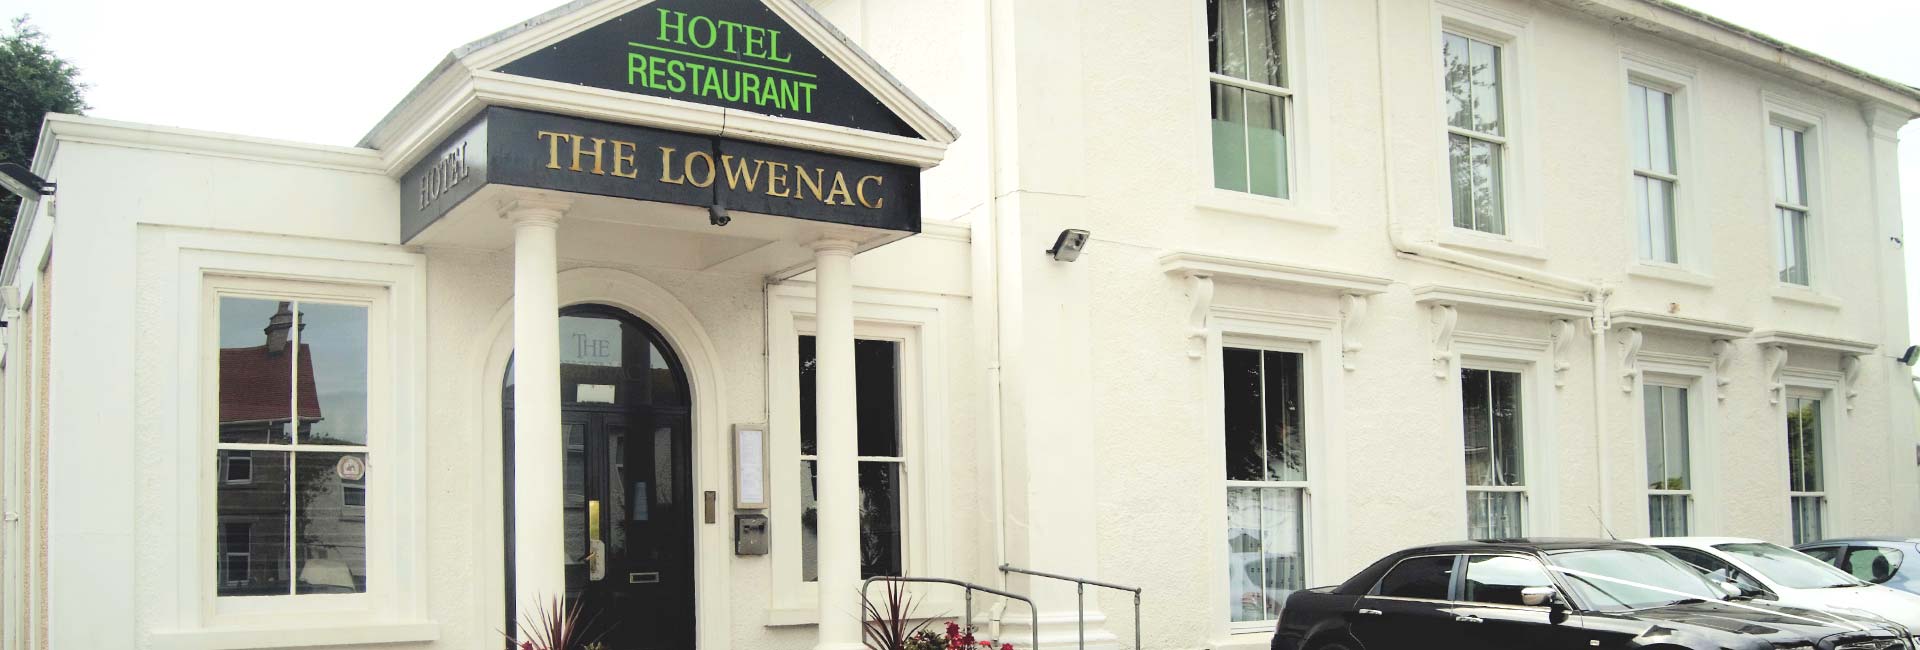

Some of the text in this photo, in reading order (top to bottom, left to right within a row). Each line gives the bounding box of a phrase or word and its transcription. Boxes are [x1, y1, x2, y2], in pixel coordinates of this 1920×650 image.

[656, 7, 792, 63] HOTEL
[627, 55, 818, 114] RESTAURANT
[418, 141, 470, 211] HOTEL
[538, 130, 884, 209] THE LOWENAC
